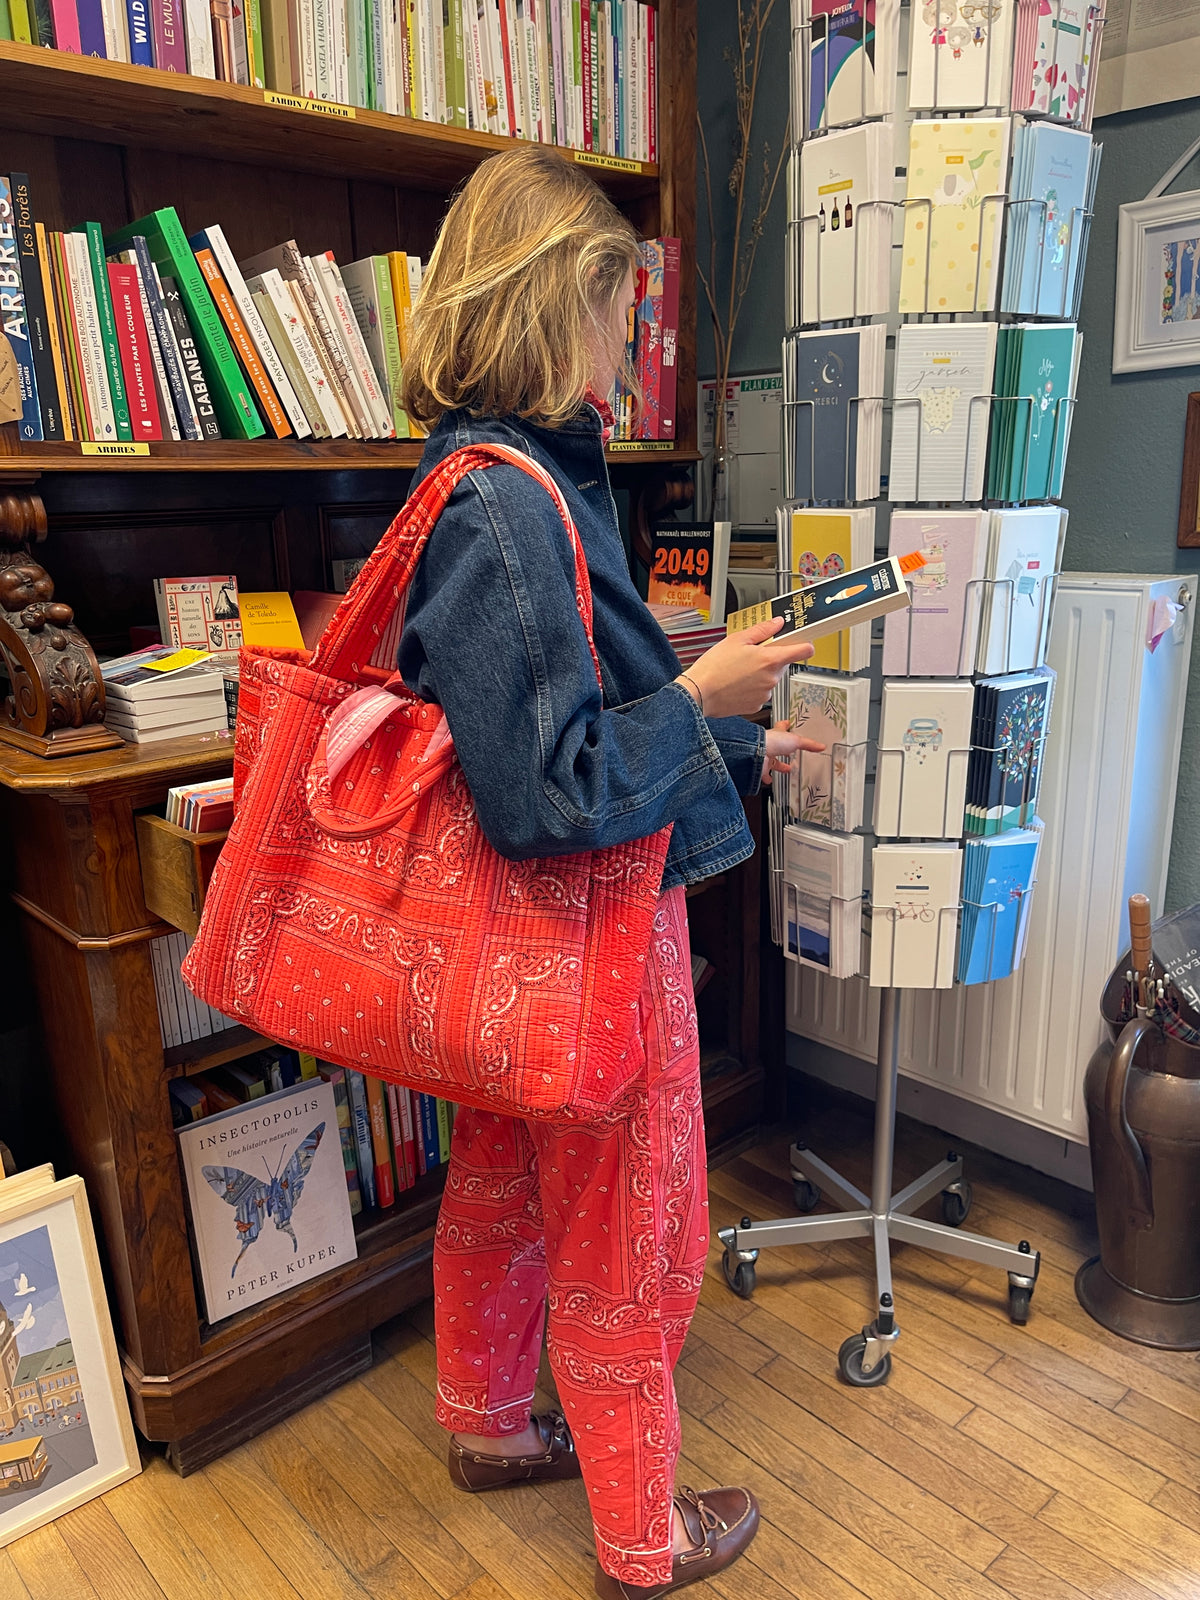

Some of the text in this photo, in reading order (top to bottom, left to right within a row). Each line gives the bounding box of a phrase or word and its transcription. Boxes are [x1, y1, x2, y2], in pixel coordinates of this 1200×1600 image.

[131, 0, 147, 43] WILD
[374, 19, 379, 30] au
[164, 26, 174, 46] LE
[318, 44, 327, 83] ANGELA
[401, 37, 409, 93] CHAMPIGNONS
[472, 23, 485, 110] PLANTES CARNIVORES
[584, 51, 589, 64] AU
[590, 30, 598, 120] PERMACULTURE
[630, 70, 636, 78] la
[270, 96, 302, 109] JARDIN
[311, 101, 349, 117] POTAGER
[531, 112, 536, 121] LE
[630, 120, 636, 130] la
[630, 132, 636, 144] De
[577, 154, 599, 163] JARDIN
[14, 184, 35, 257] Les Forêts
[200, 258, 215, 281] lonely
[206, 256, 220, 279] planet
[186, 276, 210, 310] jardin
[84, 300, 95, 328] habitat
[199, 308, 212, 320] le
[218, 292, 235, 320] monde
[382, 304, 393, 329] JARDIN
[71, 277, 93, 385] SA MAISON EN BOIS AUTONOME
[88, 329, 100, 348] petit
[231, 320, 241, 333] du
[122, 293, 147, 411] LES PLANTES PAR LA COULEUR
[241, 296, 284, 383] PAYSAGES INSOLITES
[333, 294, 378, 401] JARDINS SECRETS DU JAPON
[92, 348, 100, 359] un
[16, 362, 25, 388] RACINES
[23, 365, 31, 385] CIMES
[107, 342, 122, 399] Le quartier du futur
[178, 335, 215, 418] CABANES
[250, 362, 260, 375] les
[92, 360, 108, 411] Autonomiser
[256, 375, 268, 394] dans
[745, 380, 763, 391] PLAN
[265, 394, 284, 425] Voyages
[814, 395, 839, 406] MERCI
[96, 446, 136, 454] ARBRES
[654, 547, 710, 576] 2049
[666, 591, 692, 601] CE QUE
[200, 1099, 319, 1150] INSECTOPOLIS
[227, 1126, 299, 1158] Une histoire naturelle
[226, 1245, 337, 1301] PETER KUPER
